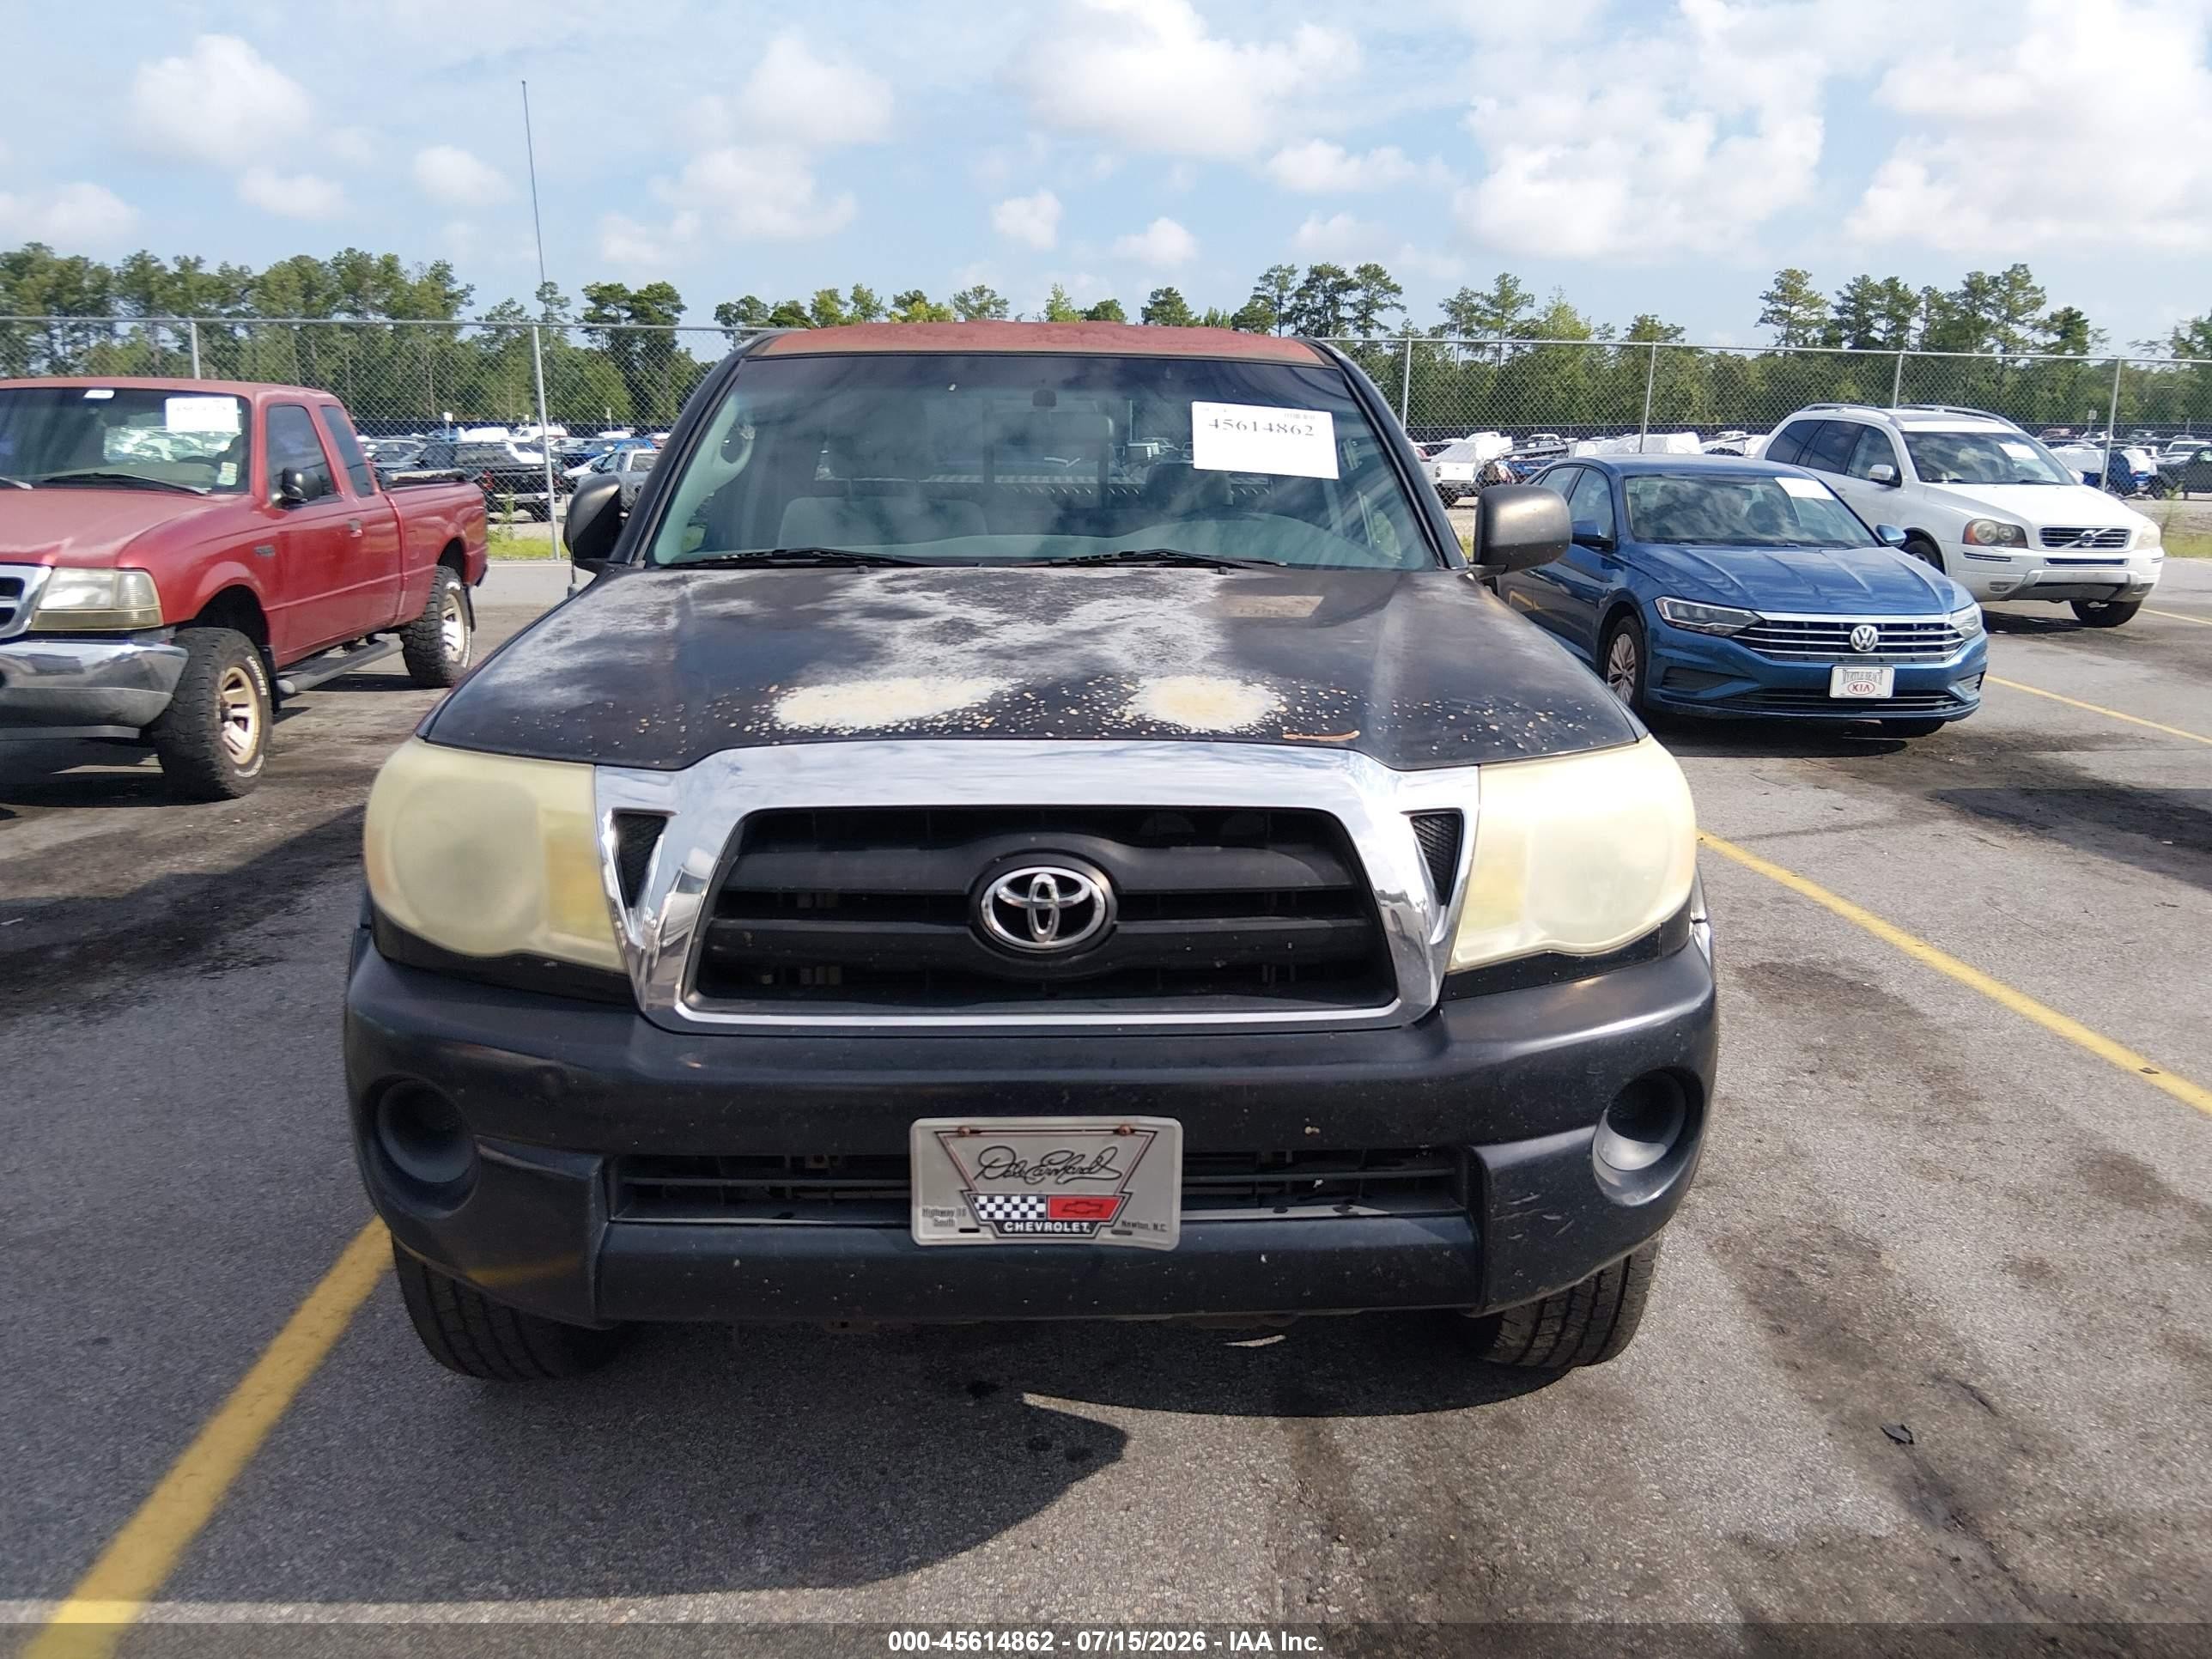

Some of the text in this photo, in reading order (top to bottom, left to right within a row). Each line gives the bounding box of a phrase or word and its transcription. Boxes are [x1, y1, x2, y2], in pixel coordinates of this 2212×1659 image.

[1208, 418, 1315, 437] 45614862
[921, 1206, 955, 1218] Highway
[933, 1216, 956, 1227] South
[1002, 1221, 1090, 1234] CHEVROLET
